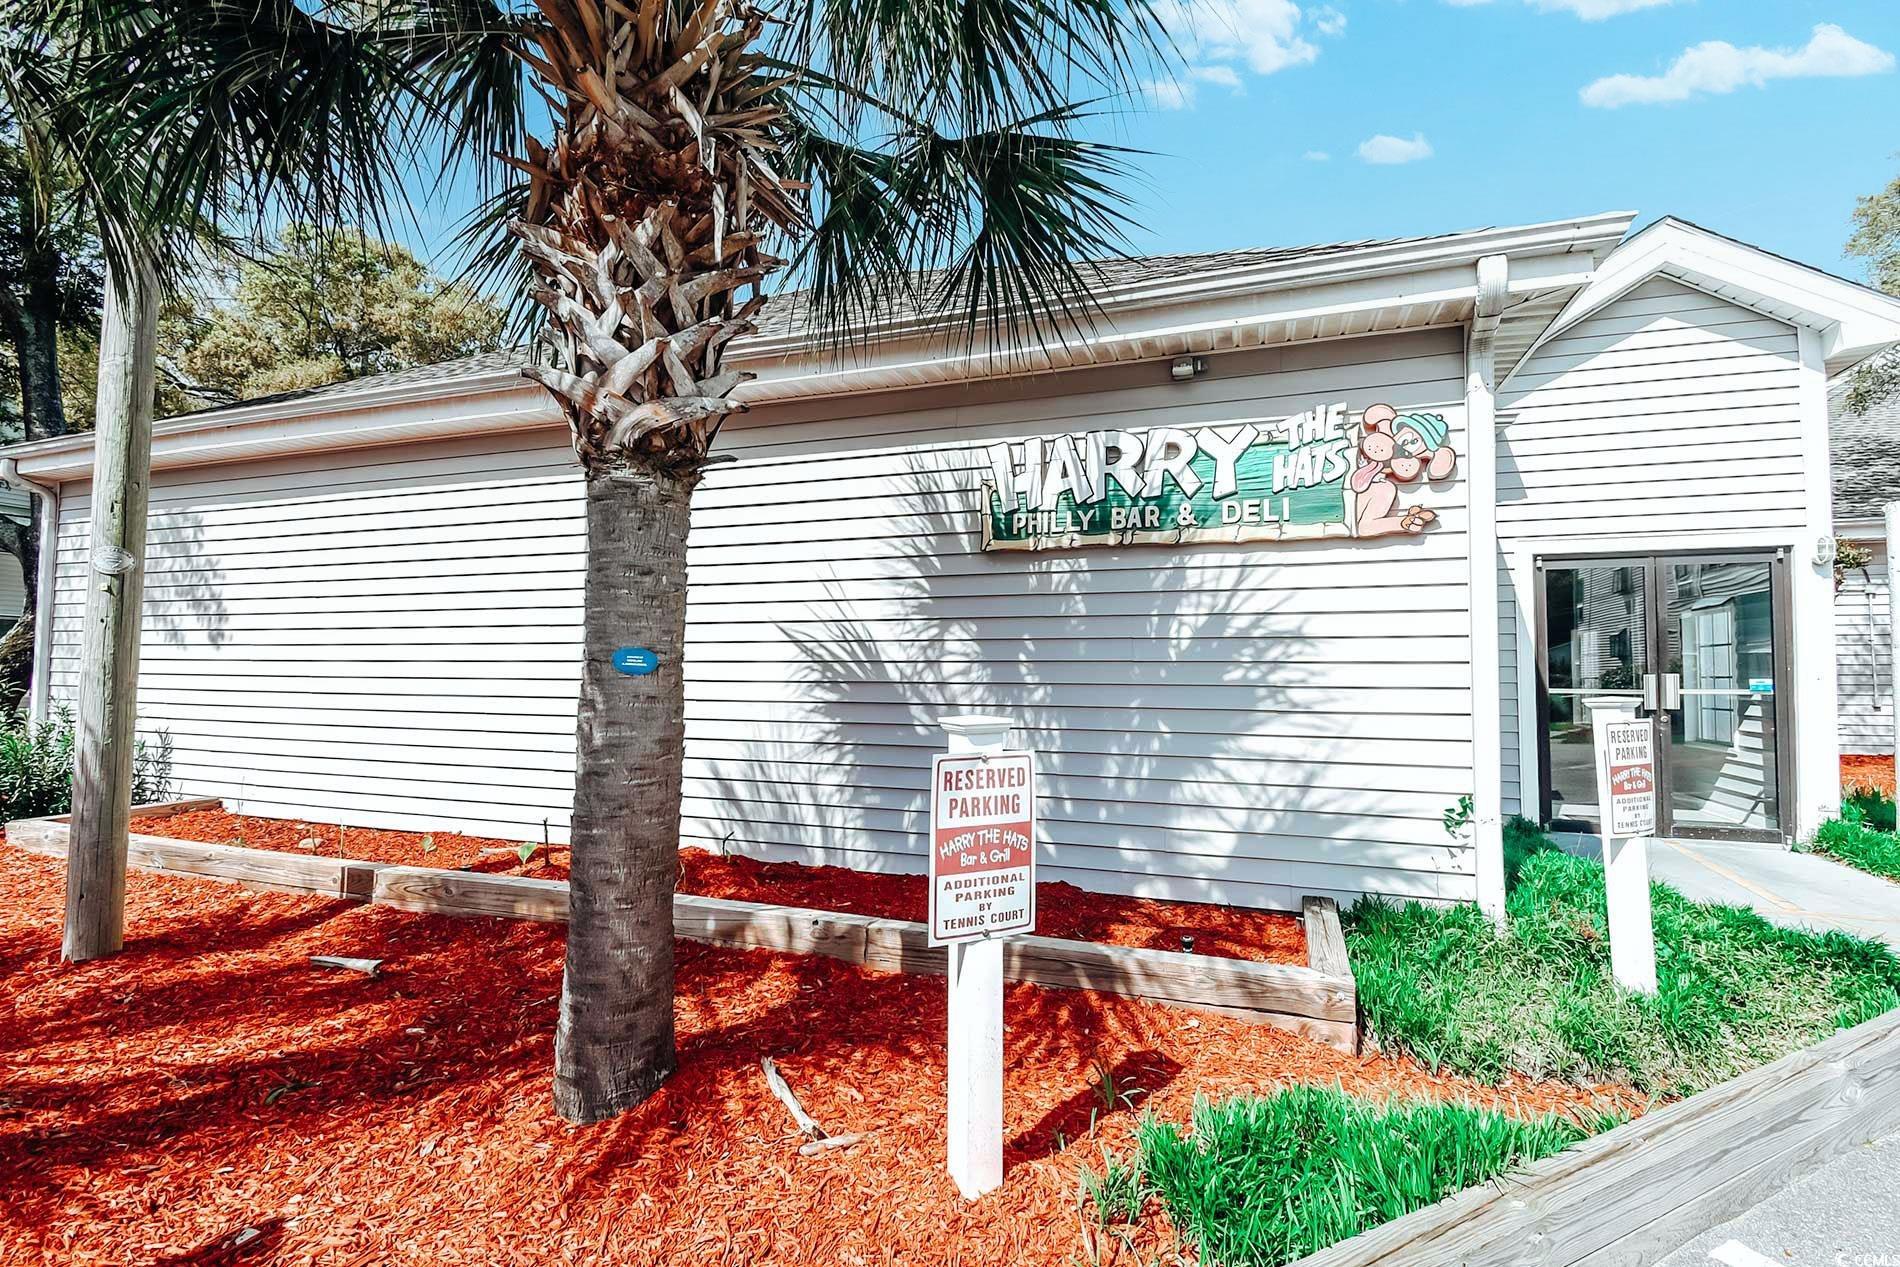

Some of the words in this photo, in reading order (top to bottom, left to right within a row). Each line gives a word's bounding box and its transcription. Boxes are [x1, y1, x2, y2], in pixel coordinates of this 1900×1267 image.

[1277, 403, 1347, 452] THE
[988, 423, 1259, 513] HARRY
[1272, 439, 1350, 494] HATS
[1012, 509, 1096, 534] PHILLY
[1111, 506, 1160, 530] BAR
[1176, 502, 1198, 526] &
[1221, 498, 1290, 524] DELI
[1610, 729, 1648, 743] RESERVED
[1615, 745, 1647, 760] PARKING
[943, 767, 1025, 791] RESERVED
[948, 794, 1021, 818] PARKING
[940, 832, 976, 860] HARRY
[977, 828, 1000, 846] THE
[1002, 830, 1029, 851] HATS
[960, 852, 977, 867] Bar
[980, 851, 988, 864] &
[989, 847, 1010, 863] Grill
[944, 872, 1025, 891] ADDITIONAL
[955, 886, 1015, 902] PARKING
[979, 902, 992, 911] BY
[943, 914, 985, 930] TENNIS
[990, 908, 1024, 923] COURT
